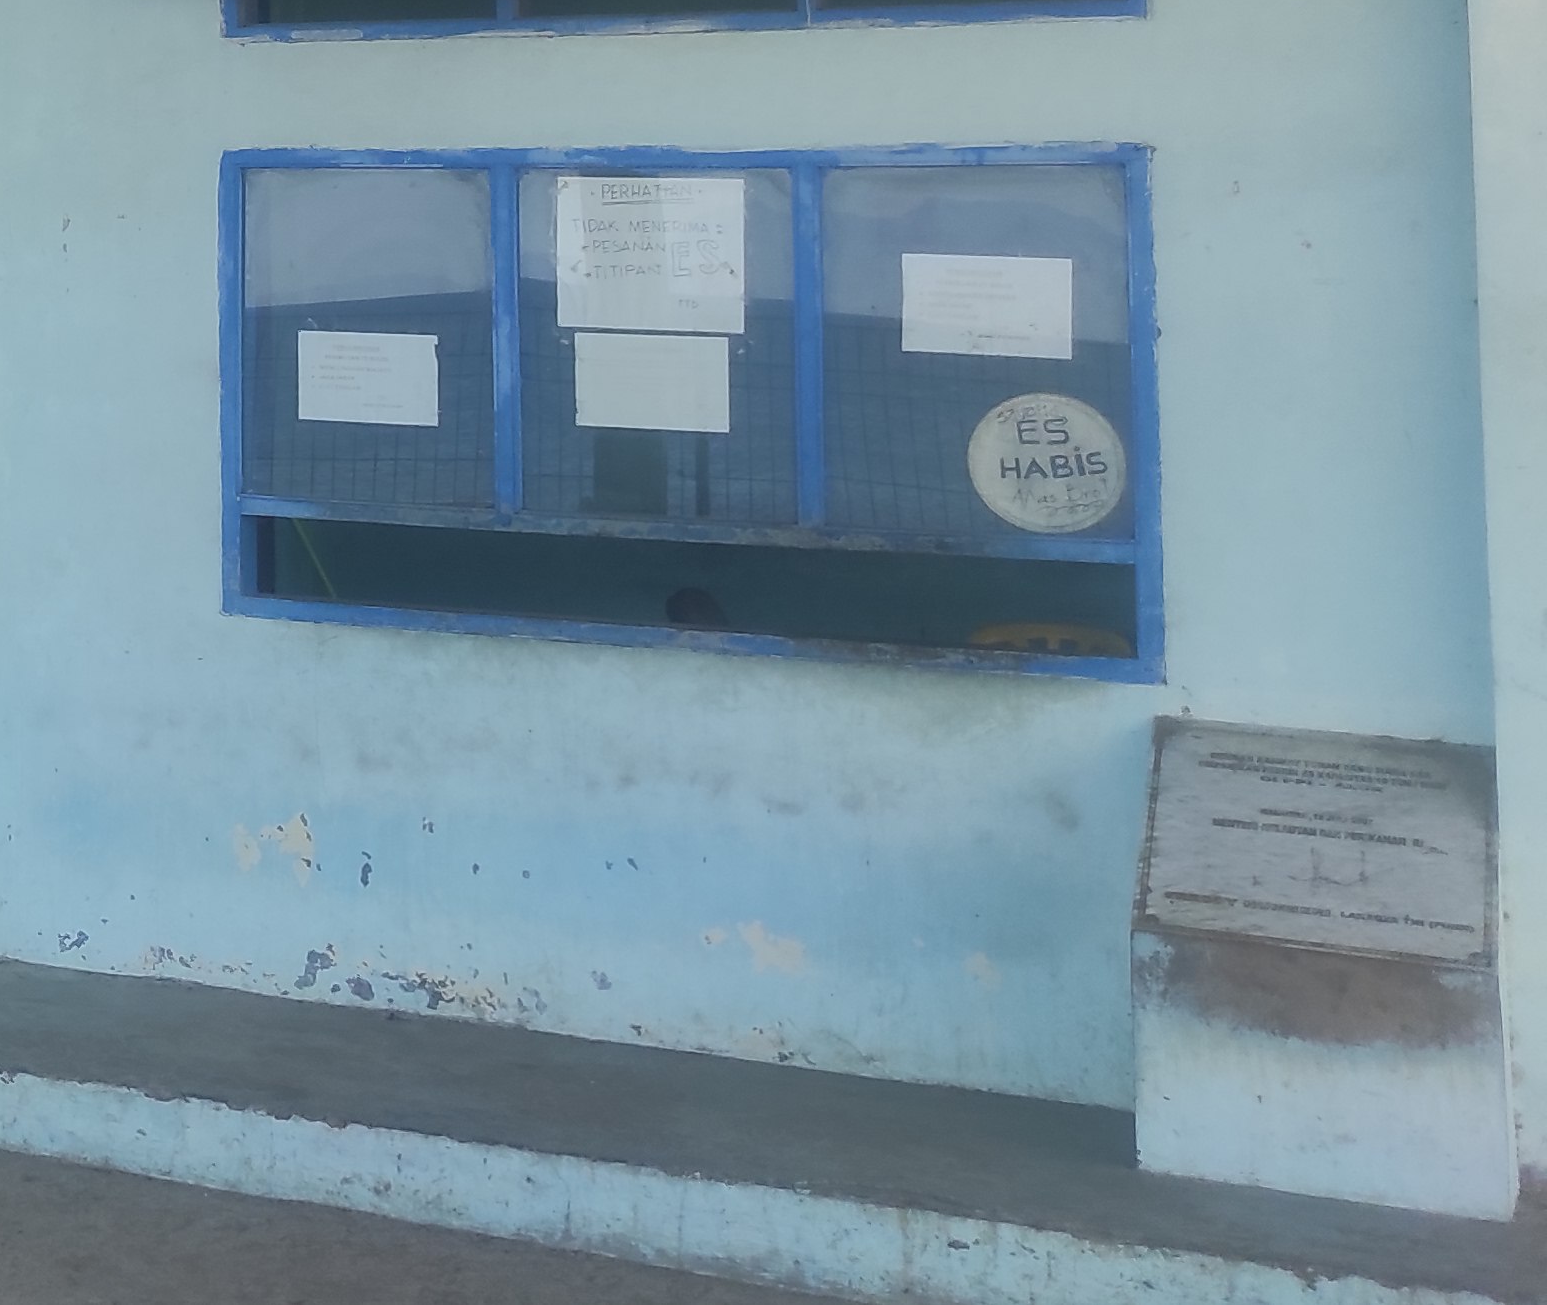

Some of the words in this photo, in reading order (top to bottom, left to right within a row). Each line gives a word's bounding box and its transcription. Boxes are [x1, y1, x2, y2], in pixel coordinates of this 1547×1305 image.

[571, 217, 619, 234] TIDAK
[629, 219, 709, 234] MENERIMA
[671, 238, 722, 278] ES
[1016, 415, 1070, 445] ES
